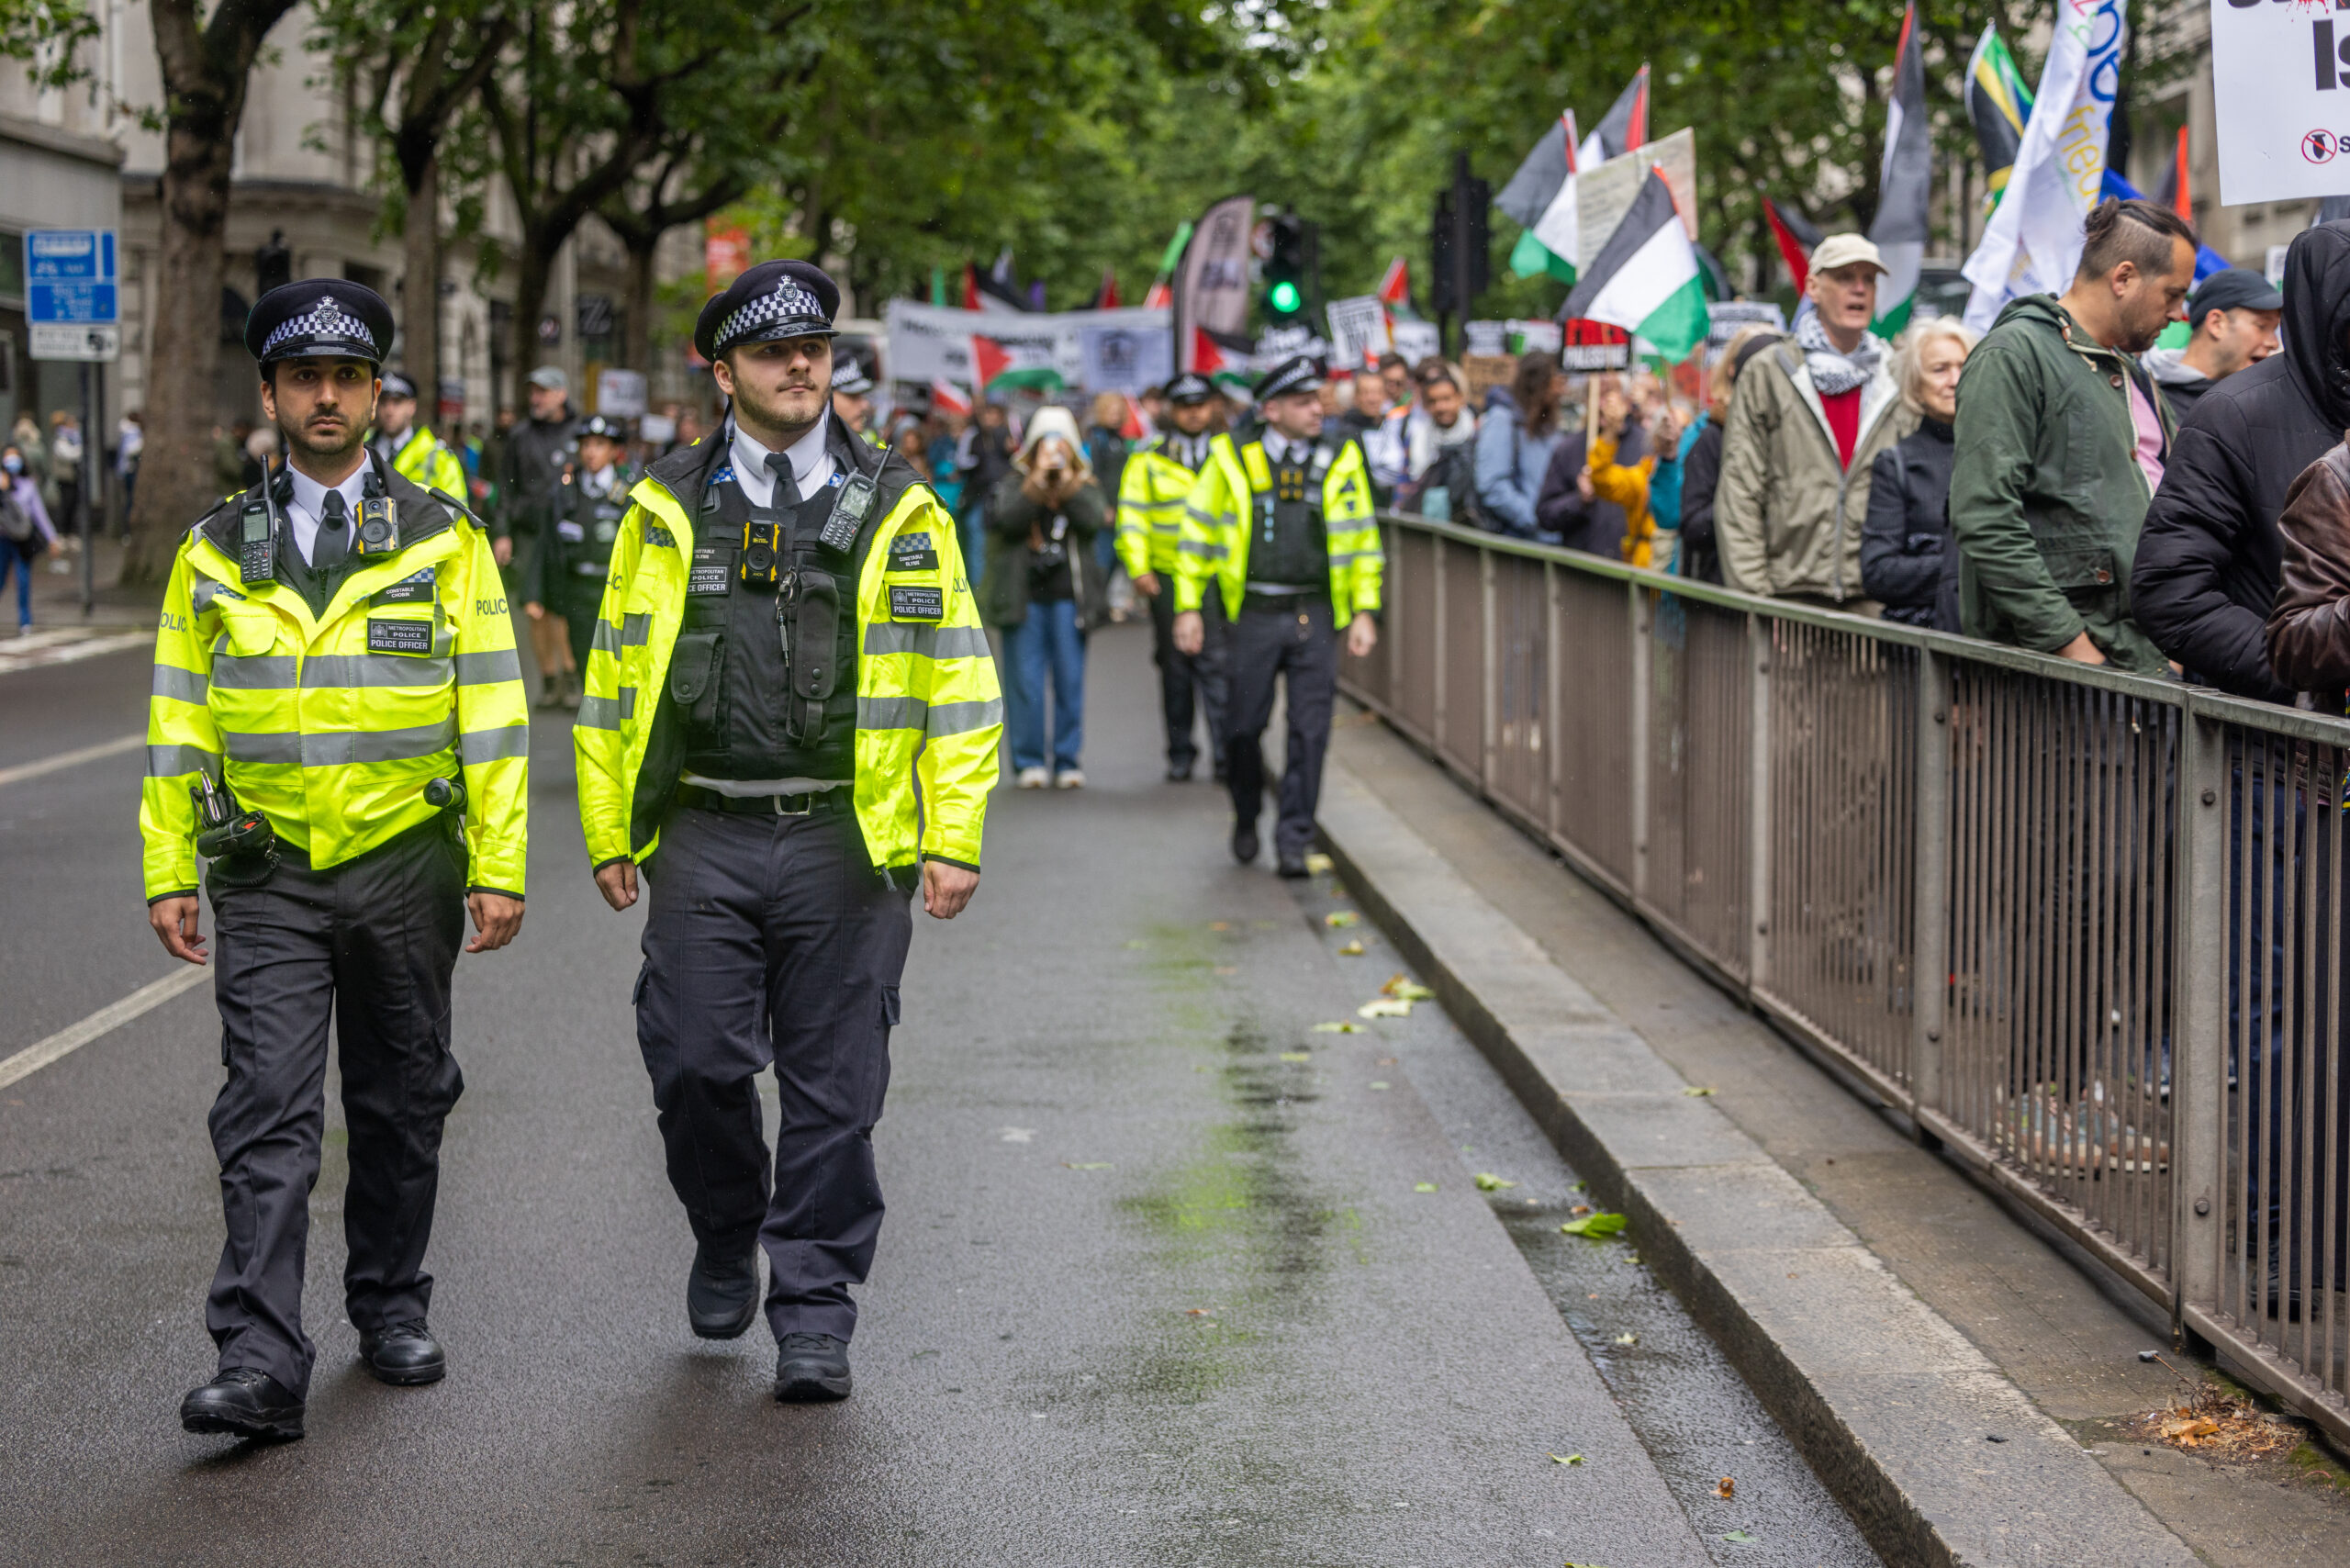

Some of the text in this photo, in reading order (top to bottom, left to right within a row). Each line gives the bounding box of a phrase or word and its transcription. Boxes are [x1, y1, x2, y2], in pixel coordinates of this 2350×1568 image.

[386, 587, 414, 595] CONSTABLE
[698, 584, 726, 592] OFFICER
[476, 598, 508, 616] POLIC
[894, 605, 942, 615] POLICE OFFICER
[160, 612, 187, 632] OLIC
[371, 639, 428, 650] POLICE OFFICER
